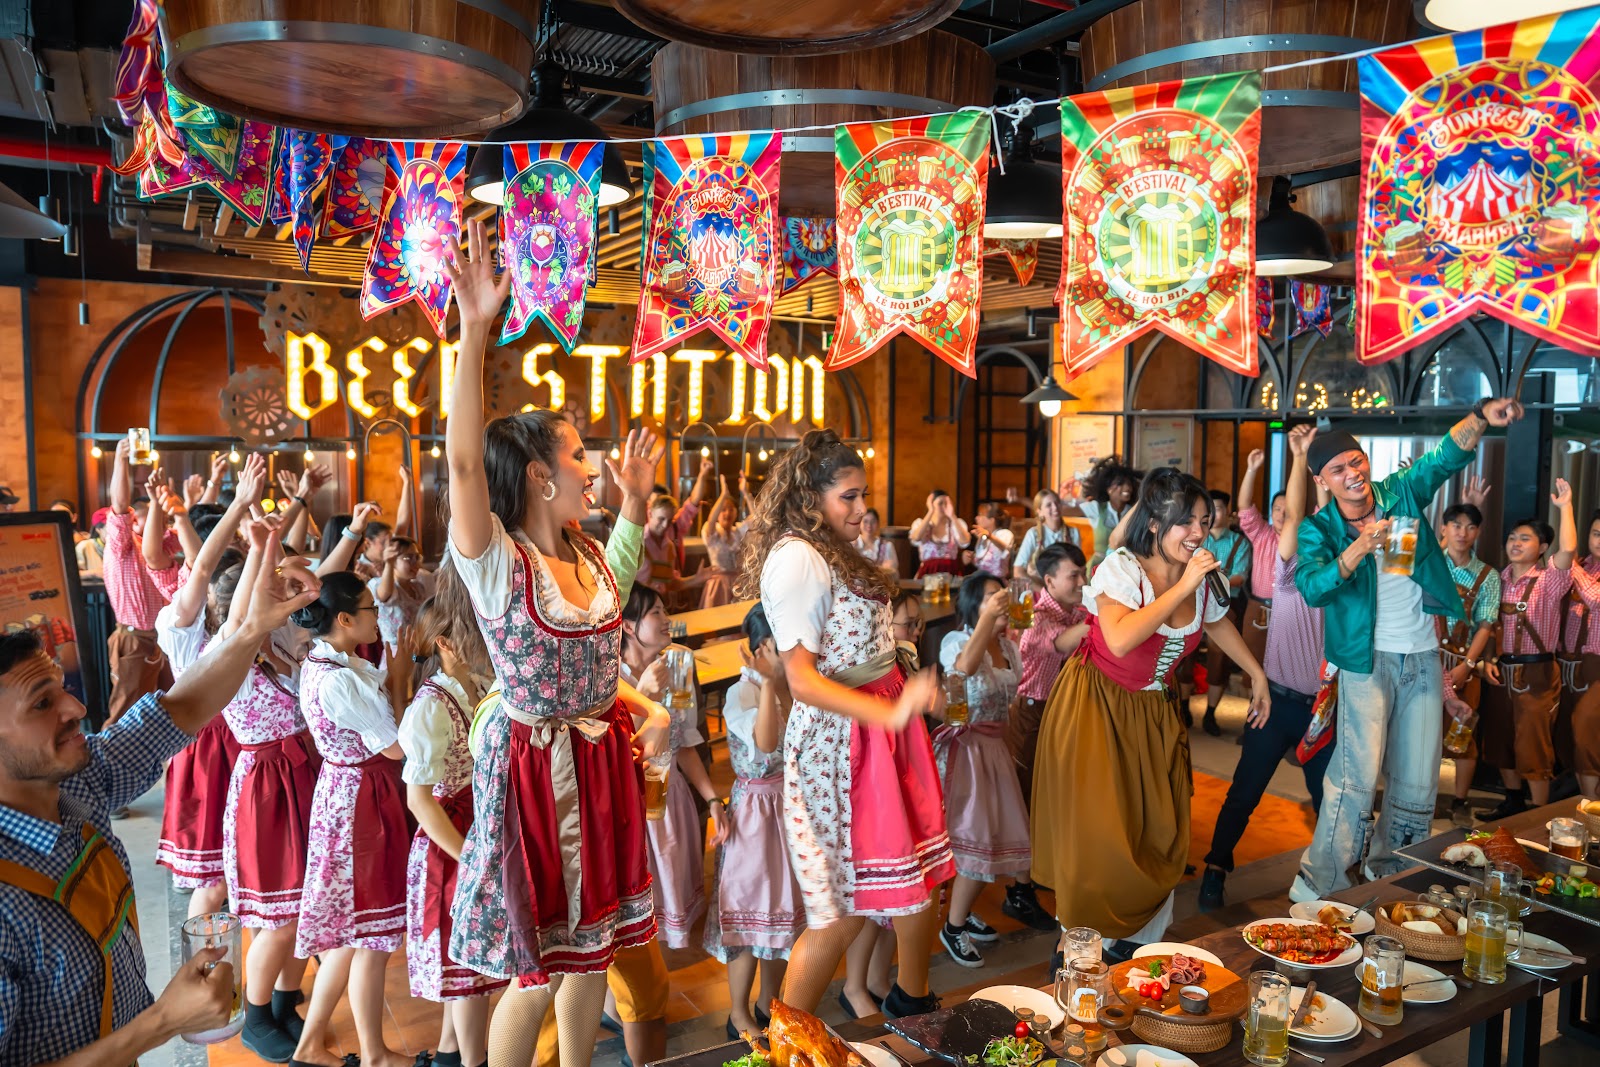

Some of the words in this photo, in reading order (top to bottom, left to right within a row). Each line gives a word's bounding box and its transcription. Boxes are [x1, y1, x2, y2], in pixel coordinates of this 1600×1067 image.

[1427, 101, 1542, 148] SUNFEST
[1122, 174, 1187, 199] B'ESTIVAL
[877, 193, 933, 214] B'ESTIVAL
[1434, 212, 1526, 246] MARKET
[913, 296, 932, 308] BIA
[1167, 287, 1189, 301] BIA
[520, 342, 825, 430] STATION
